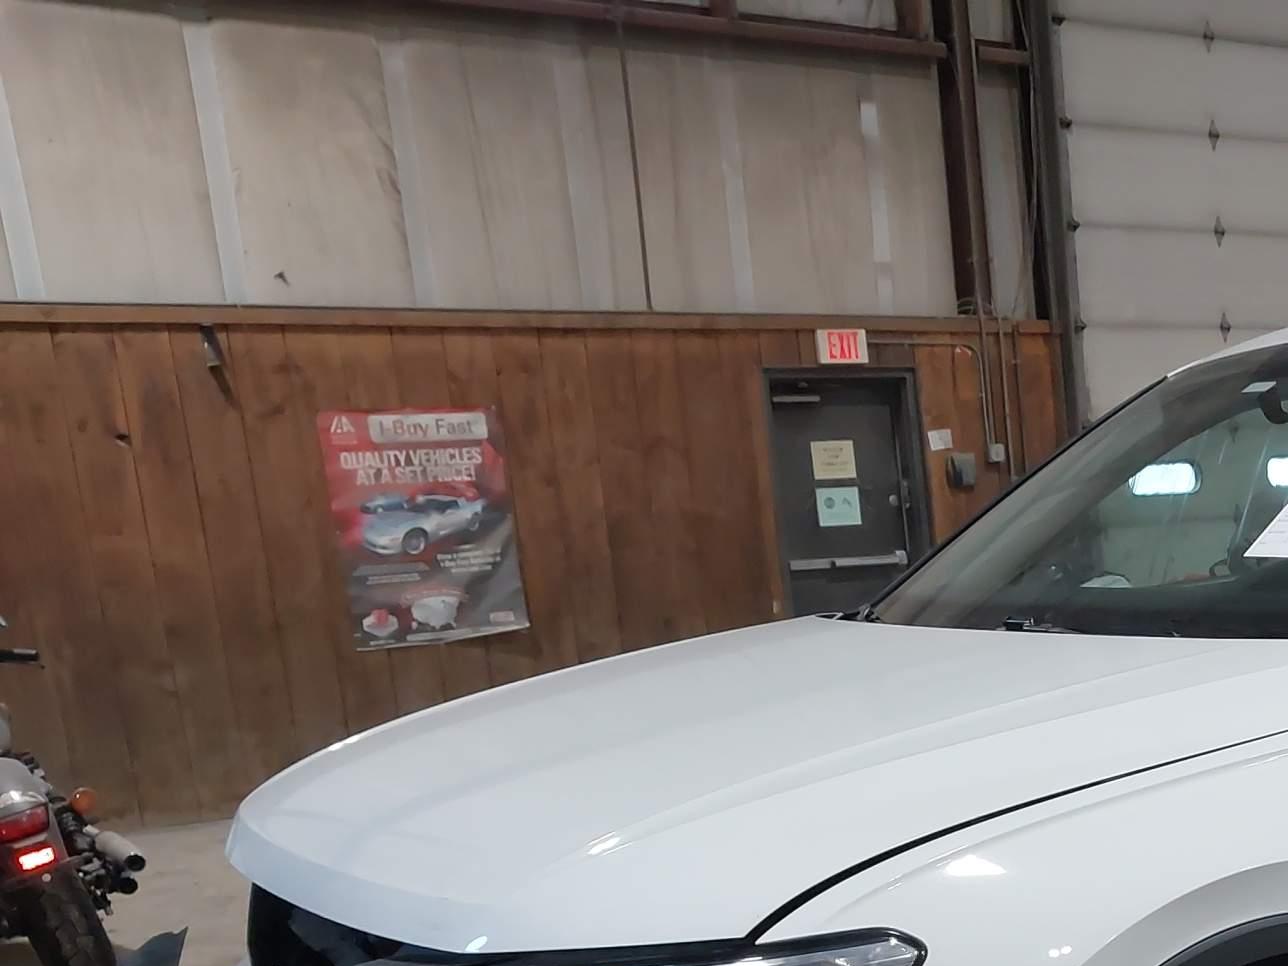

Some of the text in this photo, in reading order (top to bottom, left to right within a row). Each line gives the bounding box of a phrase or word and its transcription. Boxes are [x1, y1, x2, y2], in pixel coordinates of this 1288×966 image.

[827, 331, 860, 359] EXIT
[379, 418, 474, 437] I-Buy Fast
[340, 447, 483, 469] QUALITY VEHICLES
[356, 465, 476, 486] AT A SET PRICE!
